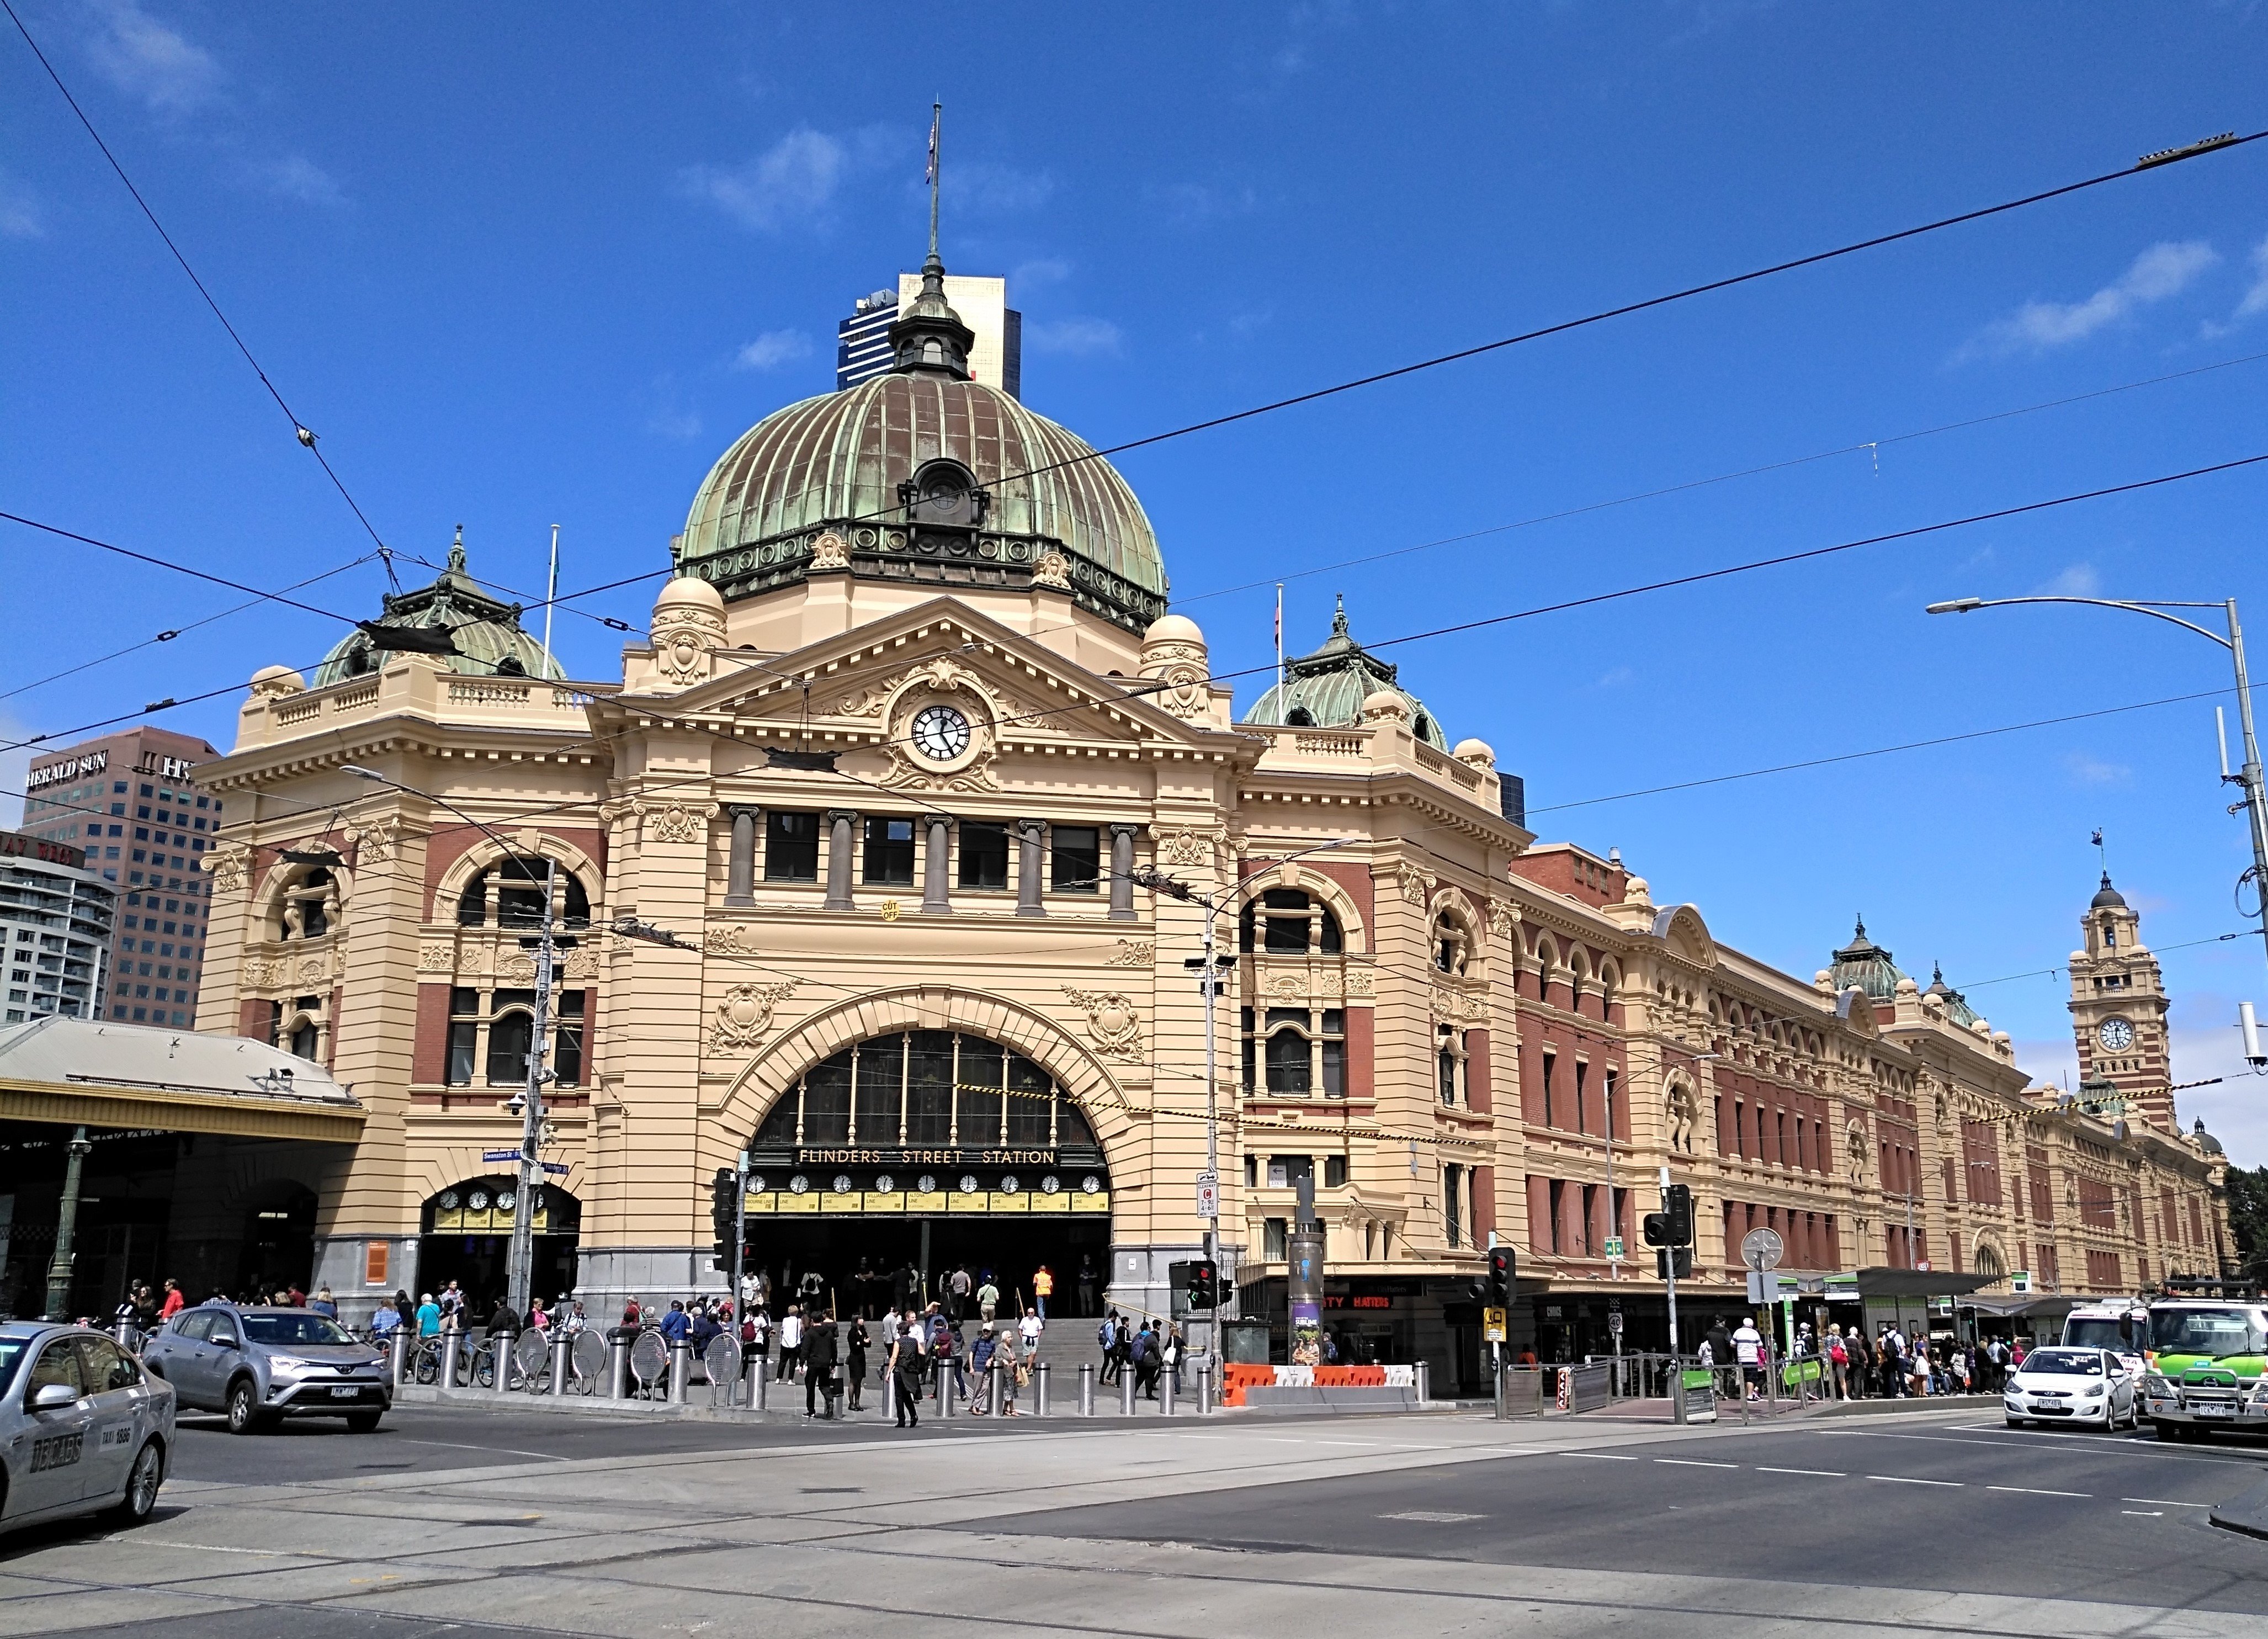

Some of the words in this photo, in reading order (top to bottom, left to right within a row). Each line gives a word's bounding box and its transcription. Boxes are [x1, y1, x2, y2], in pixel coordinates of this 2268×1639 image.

[25, 760, 77, 787] HERALD
[80, 752, 107, 773] SUN
[800, 1150, 880, 1163] FLINDERS
[902, 1150, 962, 1164] STREET
[982, 1150, 1054, 1164] STATION
[1204, 1190, 1210, 1199] C
[1354, 1297, 1389, 1307] HATTERS
[1547, 1306, 1562, 1317] CHOICE
[102, 1431, 114, 1445] TAXI
[116, 1426, 131, 1445] 1886
[30, 1431, 84, 1473] 13CABS
